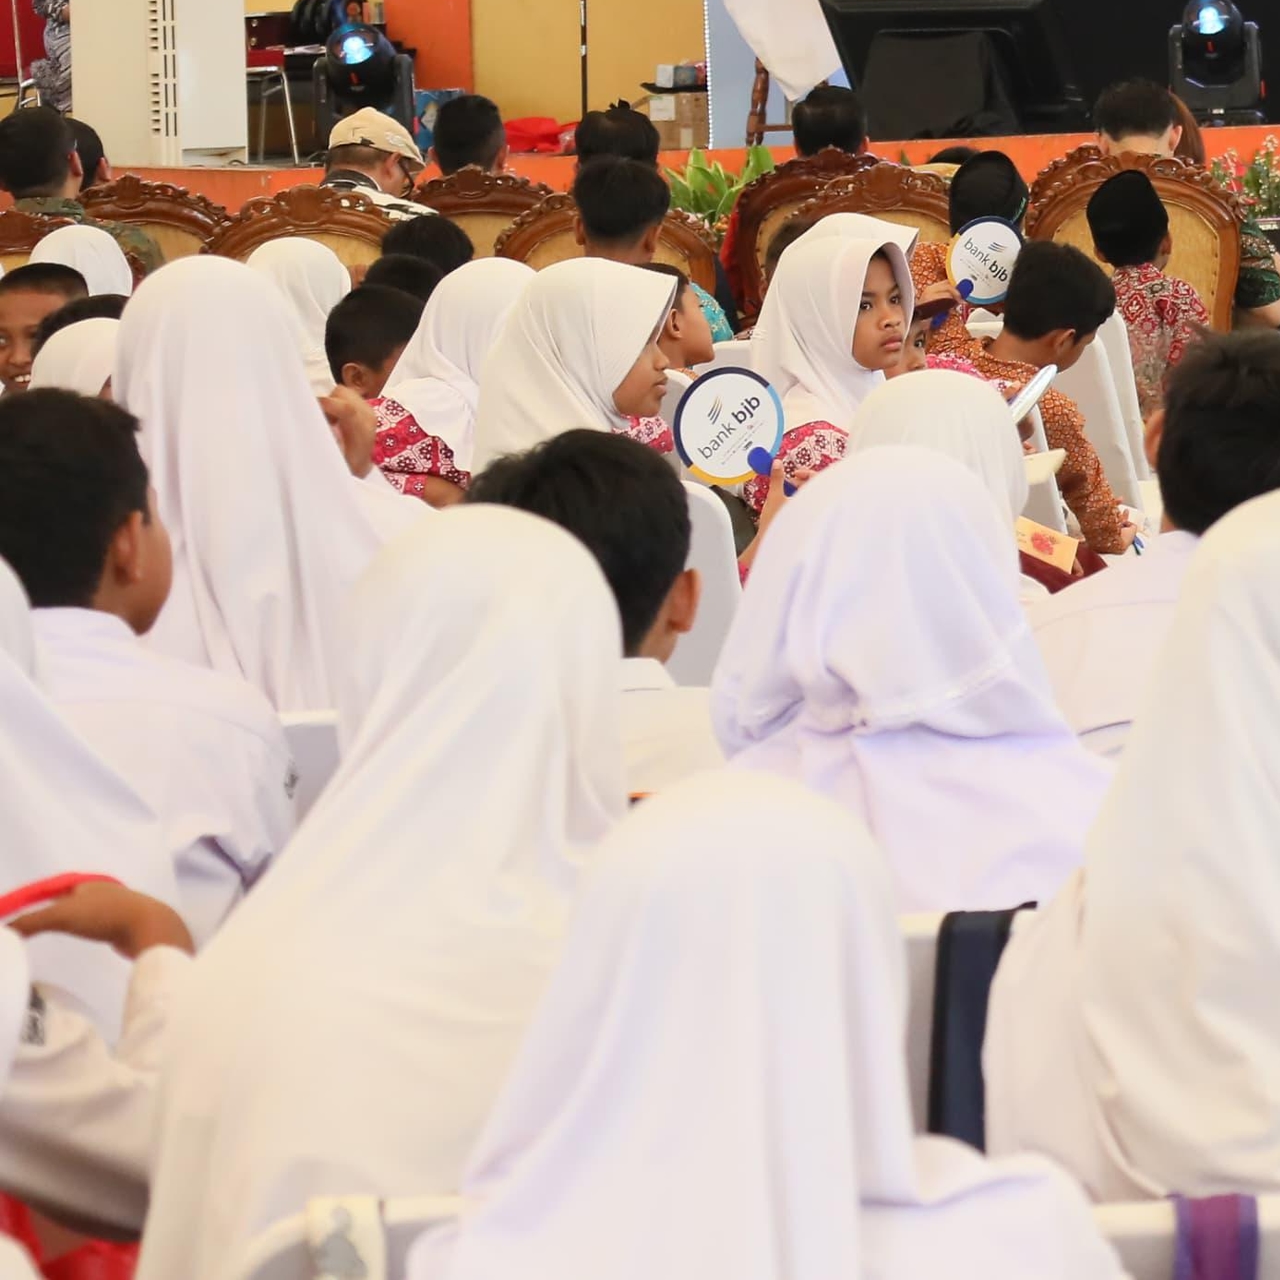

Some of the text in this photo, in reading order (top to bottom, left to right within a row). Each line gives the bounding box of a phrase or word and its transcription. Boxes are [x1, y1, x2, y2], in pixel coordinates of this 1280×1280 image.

[963, 237, 991, 266] bank
[988, 260, 1009, 282] bjb
[697, 422, 737, 460] bank
[731, 396, 761, 424] bjb
